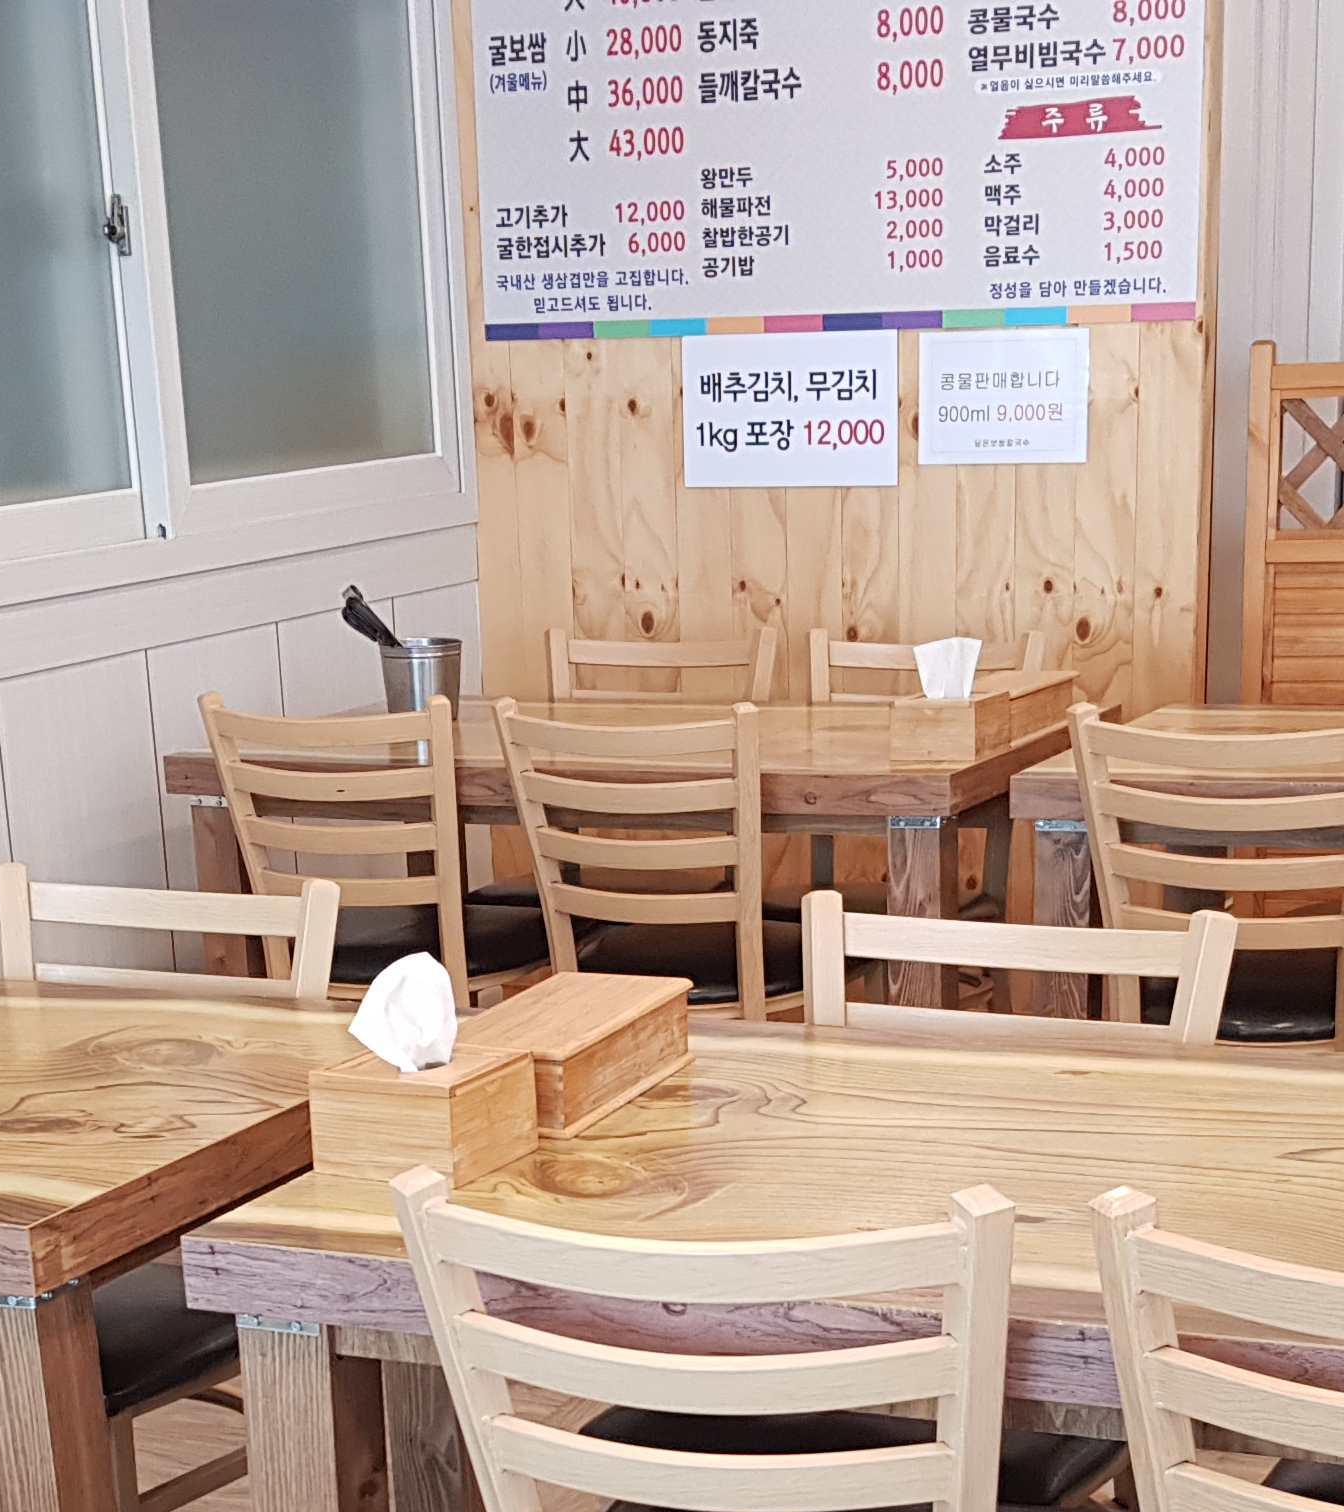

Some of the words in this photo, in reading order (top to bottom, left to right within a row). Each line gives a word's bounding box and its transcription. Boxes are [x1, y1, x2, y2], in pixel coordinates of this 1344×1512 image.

[698, 18, 758, 53] 동지죽
[877, 6, 943, 42] 8,000
[968, 4, 1059, 34] 콩물국수
[489, 32, 546, 66] 굴보쌈
[567, 30, 586, 62] 小
[607, 24, 681, 60] 28,000
[969, 39, 1106, 72] 열무비빔국수
[1113, 34, 1184, 64] 7,000
[490, 70, 547, 94] (겨울메뉴)
[568, 80, 587, 112] 中
[608, 76, 682, 110] 36,000
[699, 67, 801, 103] 들깨칼국수
[878, 59, 943, 95] 8,000
[570, 130, 589, 162] 大
[609, 126, 683, 161] 43,000
[701, 167, 753, 189] 왕만두
[887, 157, 943, 181] 5,000
[984, 154, 1021, 174] 소주
[1104, 146, 1164, 171] 4,000
[701, 195, 770, 218] 해물파전
[875, 188, 943, 212] 13,000
[985, 185, 1021, 206] 맥주
[1104, 178, 1164, 202] 4,000
[496, 204, 568, 229] 고기추가
[616, 200, 684, 226] 12,000
[985, 214, 1039, 236] 막걸리
[1104, 209, 1163, 233] 3,000
[497, 234, 605, 260] 굴한접시추가
[629, 231, 685, 256] 6,000
[703, 225, 788, 248] 찰밥한공기
[887, 219, 943, 242] 2,000
[703, 256, 754, 278] 공기밥
[888, 249, 943, 272] 1,000
[984, 245, 1040, 267] 음료수
[1104, 240, 1162, 264] 1,500
[497, 274, 535, 291] 국내산
[542, 271, 608, 290] 생삼겹만을
[615, 268, 688, 286] 고집합니다.
[990, 282, 1032, 299] 정성을
[1040, 281, 1067, 297] 담아
[1074, 277, 1166, 296] 만들겠습니다.
[534, 296, 600, 313] 믿고드셔도
[607, 294, 651, 311] 됩니다.
[700, 371, 798, 402] 배추김치,
[806, 369, 876, 401] 무김치
[941, 371, 1059, 390] 콩물판매합니다
[939, 405, 989, 422] 900ml
[997, 403, 1062, 422] 9,000원
[697, 422, 737, 452] 1kg
[745, 420, 794, 450] 포장
[804, 419, 884, 450] 12,000
